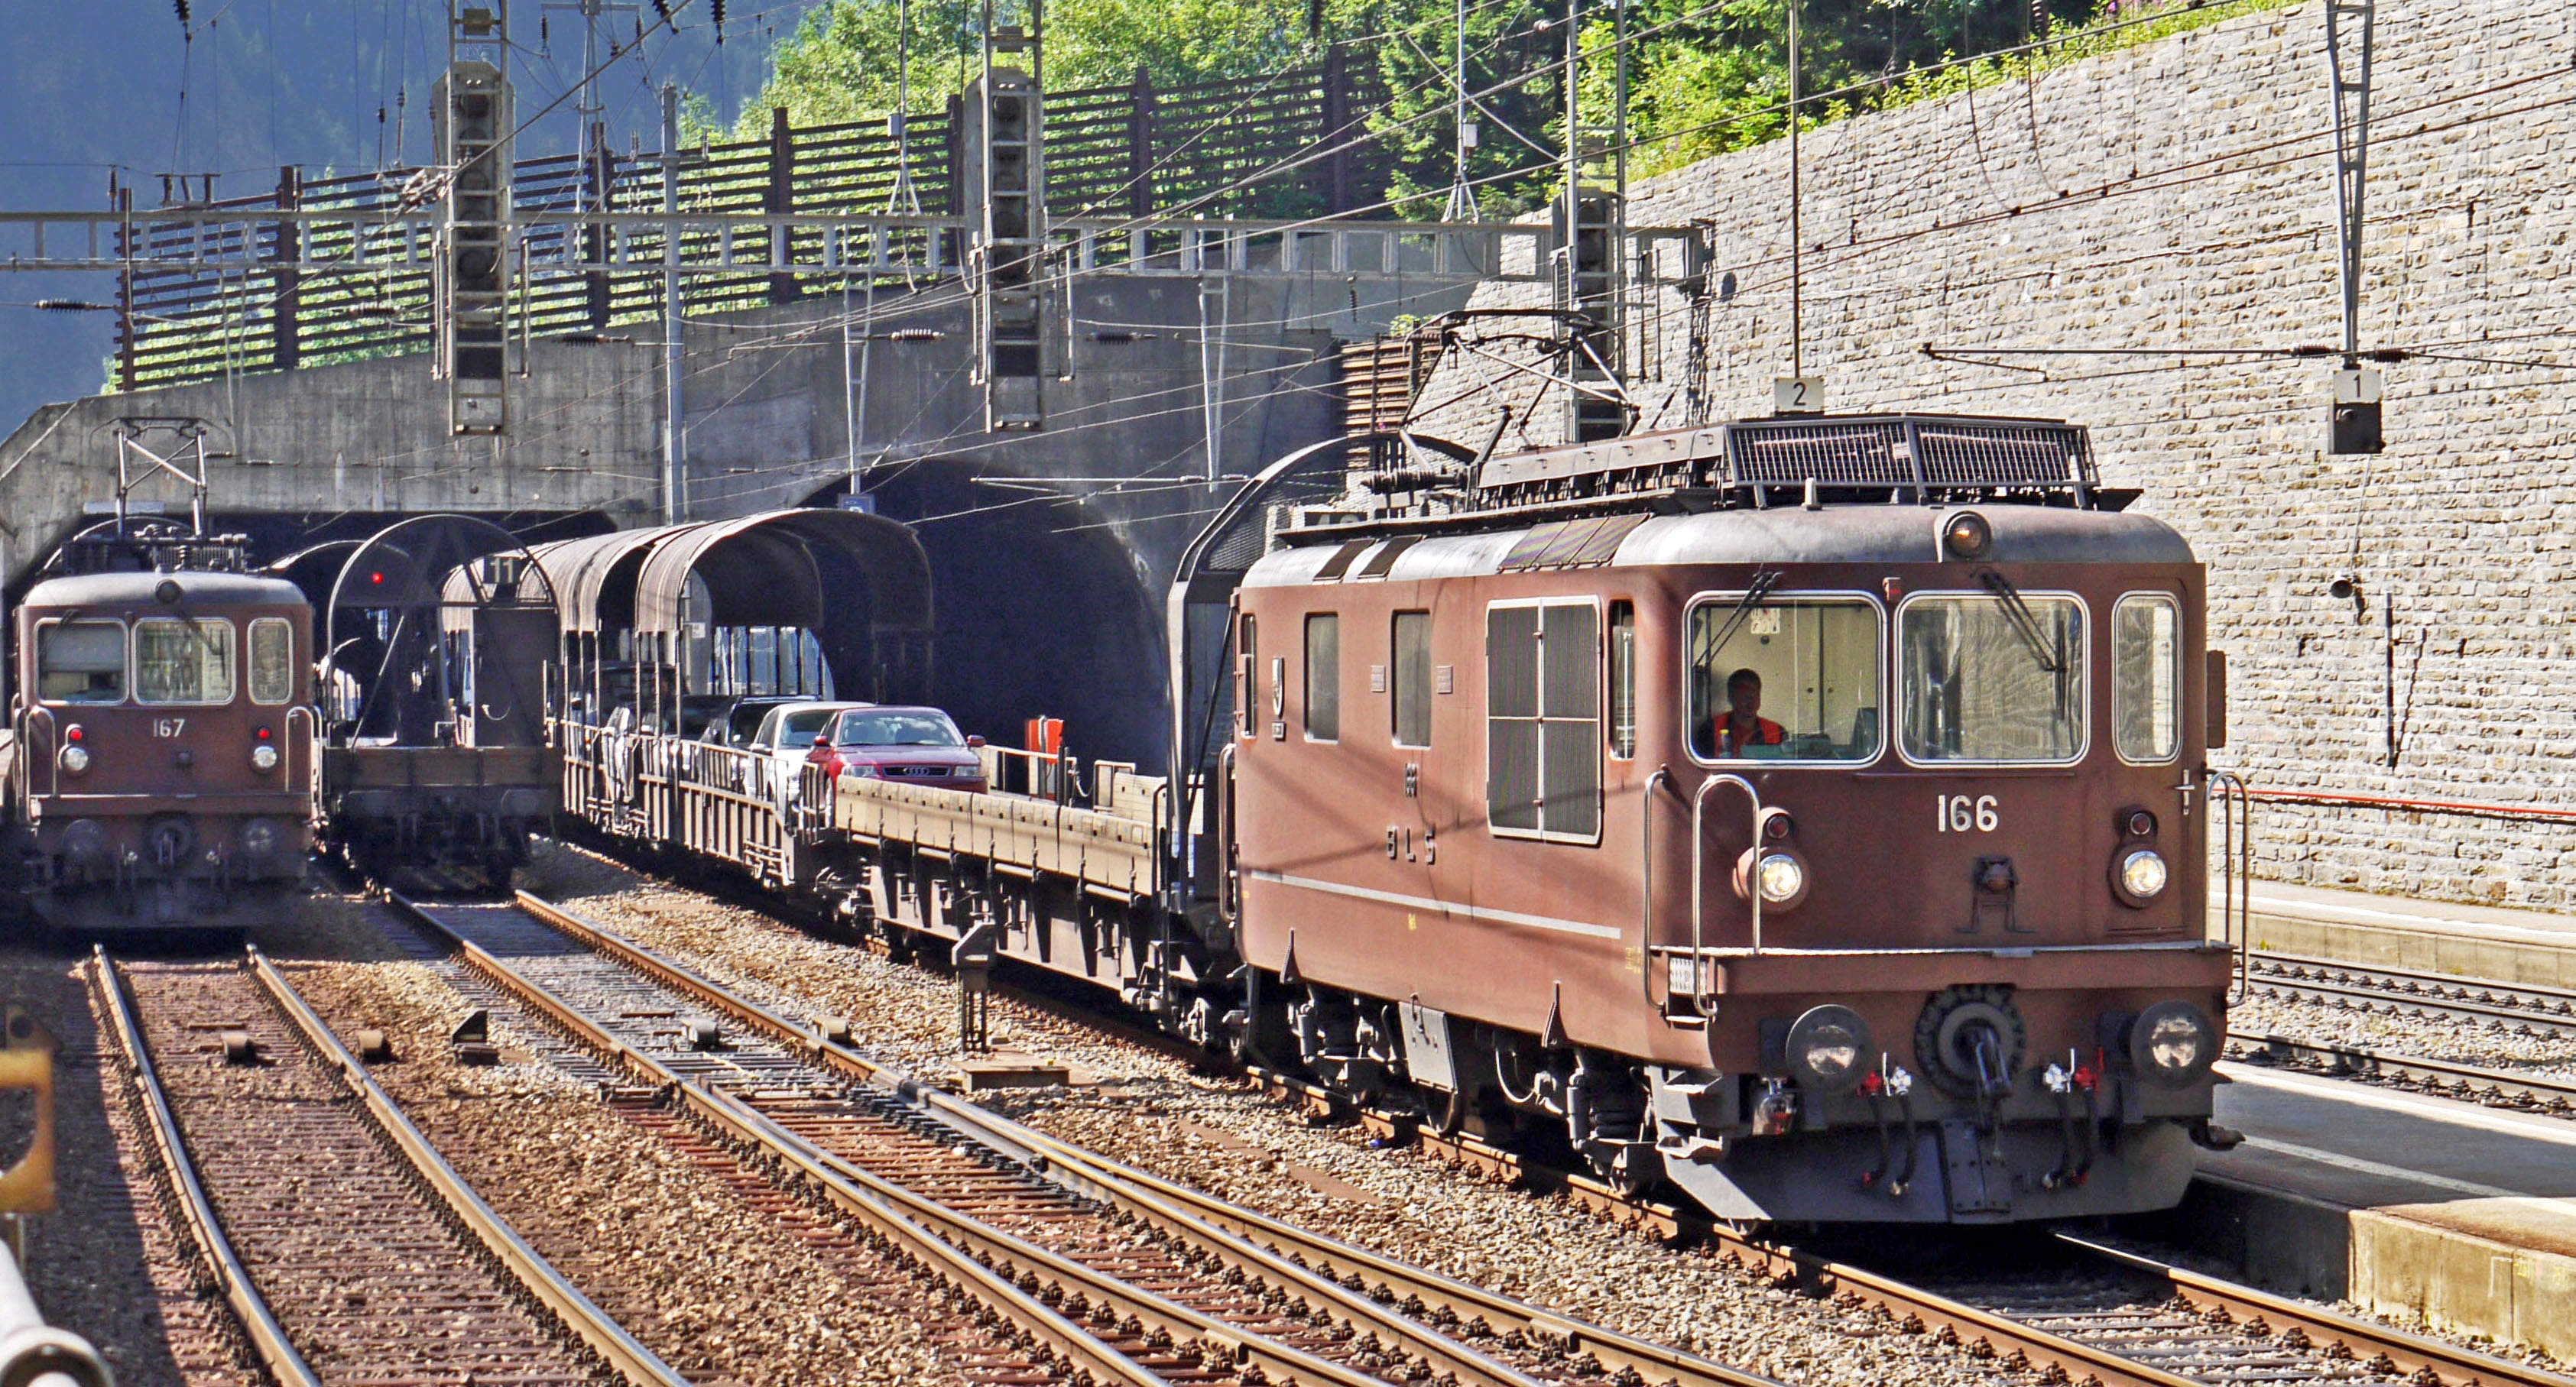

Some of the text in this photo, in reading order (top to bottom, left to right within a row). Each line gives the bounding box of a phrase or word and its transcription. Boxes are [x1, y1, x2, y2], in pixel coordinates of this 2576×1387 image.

[1793, 381, 1806, 406] 2
[2354, 374, 2360, 397] 1
[490, 558, 513, 583] 11
[153, 718, 185, 737] 167
[1938, 795, 1998, 832] 166
[1387, 825, 1436, 864] BLS
